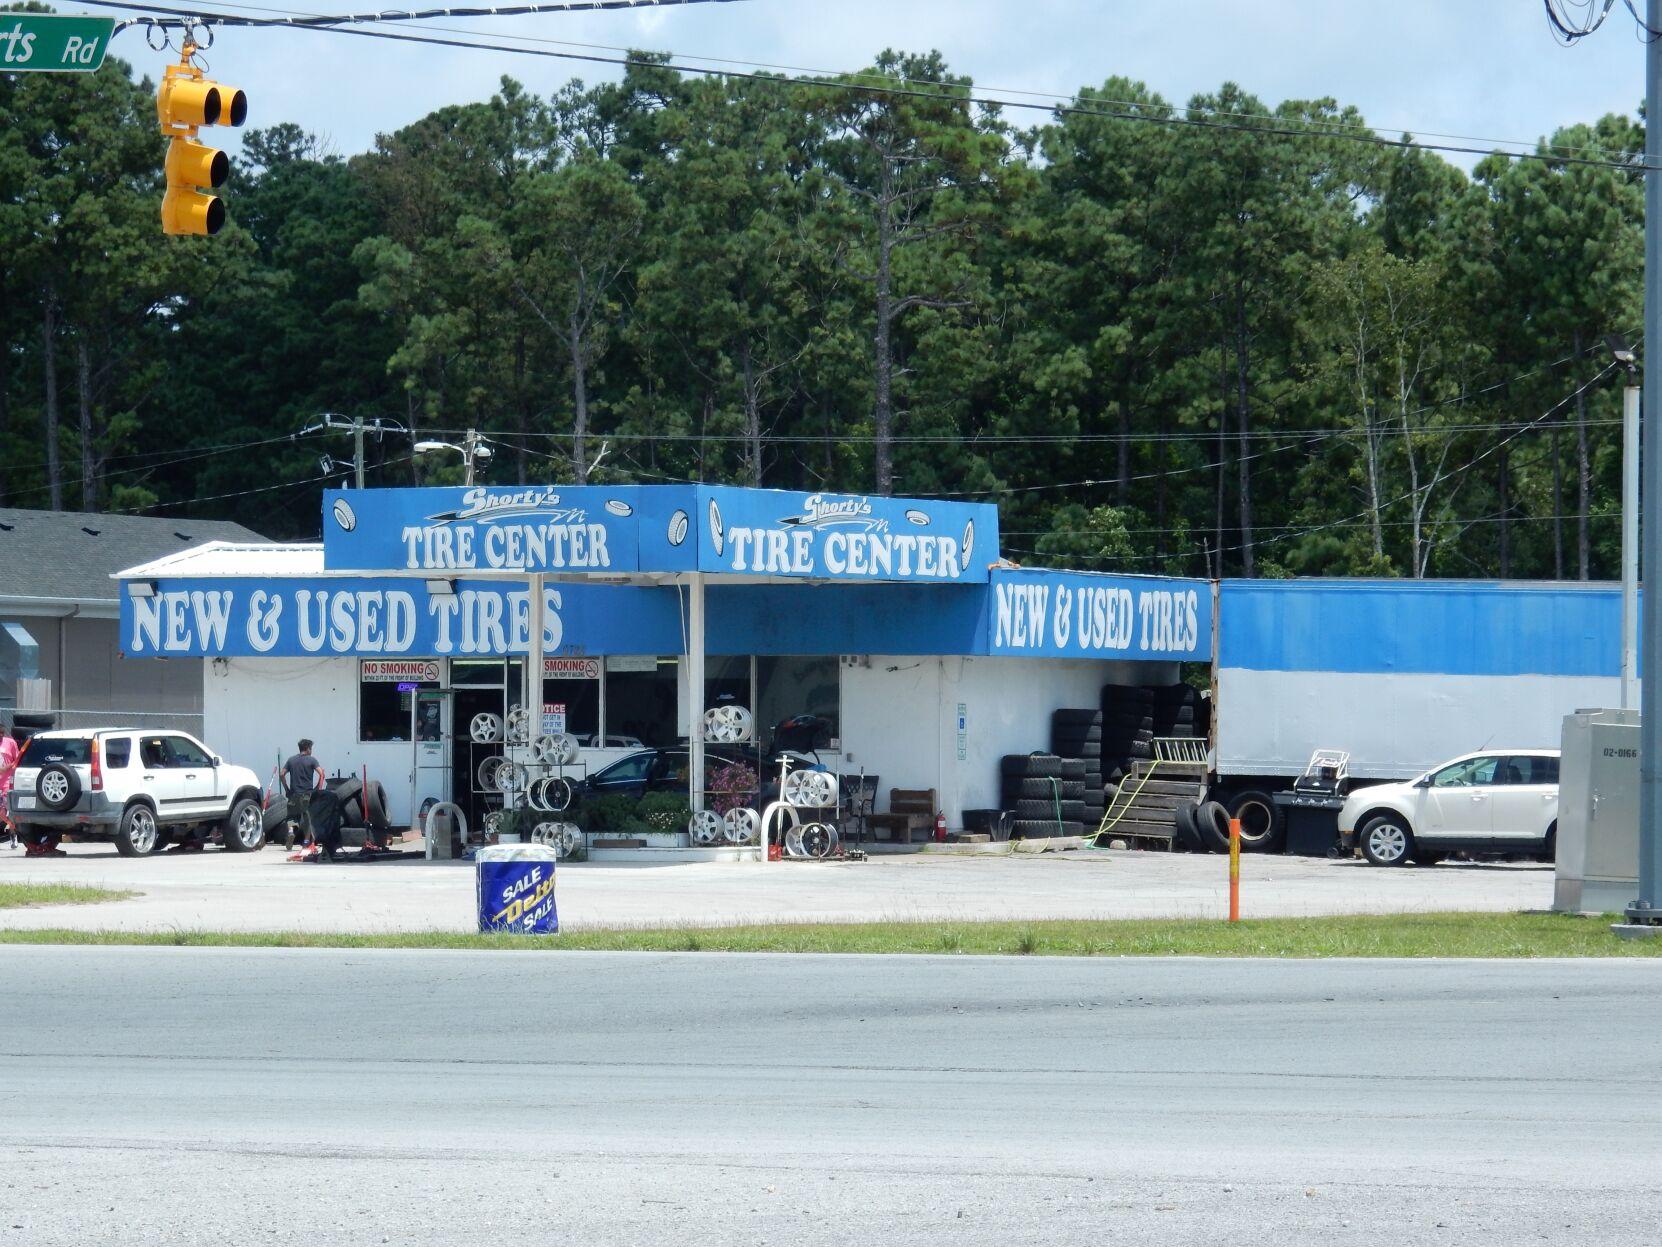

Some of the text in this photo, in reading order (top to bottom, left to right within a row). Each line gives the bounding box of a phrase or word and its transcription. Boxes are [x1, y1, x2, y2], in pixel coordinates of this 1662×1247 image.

[61, 36, 99, 64] Rd
[460, 486, 560, 518] Shorty's
[801, 494, 872, 524] Shorty's
[402, 523, 612, 569] TIRE CENTER
[728, 526, 960, 578] TIRE CENTER
[131, 588, 563, 654] NEW & USED TIRES
[995, 582, 1198, 652] NEW & USED TIRES
[364, 662, 424, 674] NO SMOKING
[544, 660, 585, 672] SMOKING
[542, 704, 566, 713] TICE
[502, 865, 542, 904] SALE
[523, 894, 553, 931] SALE
